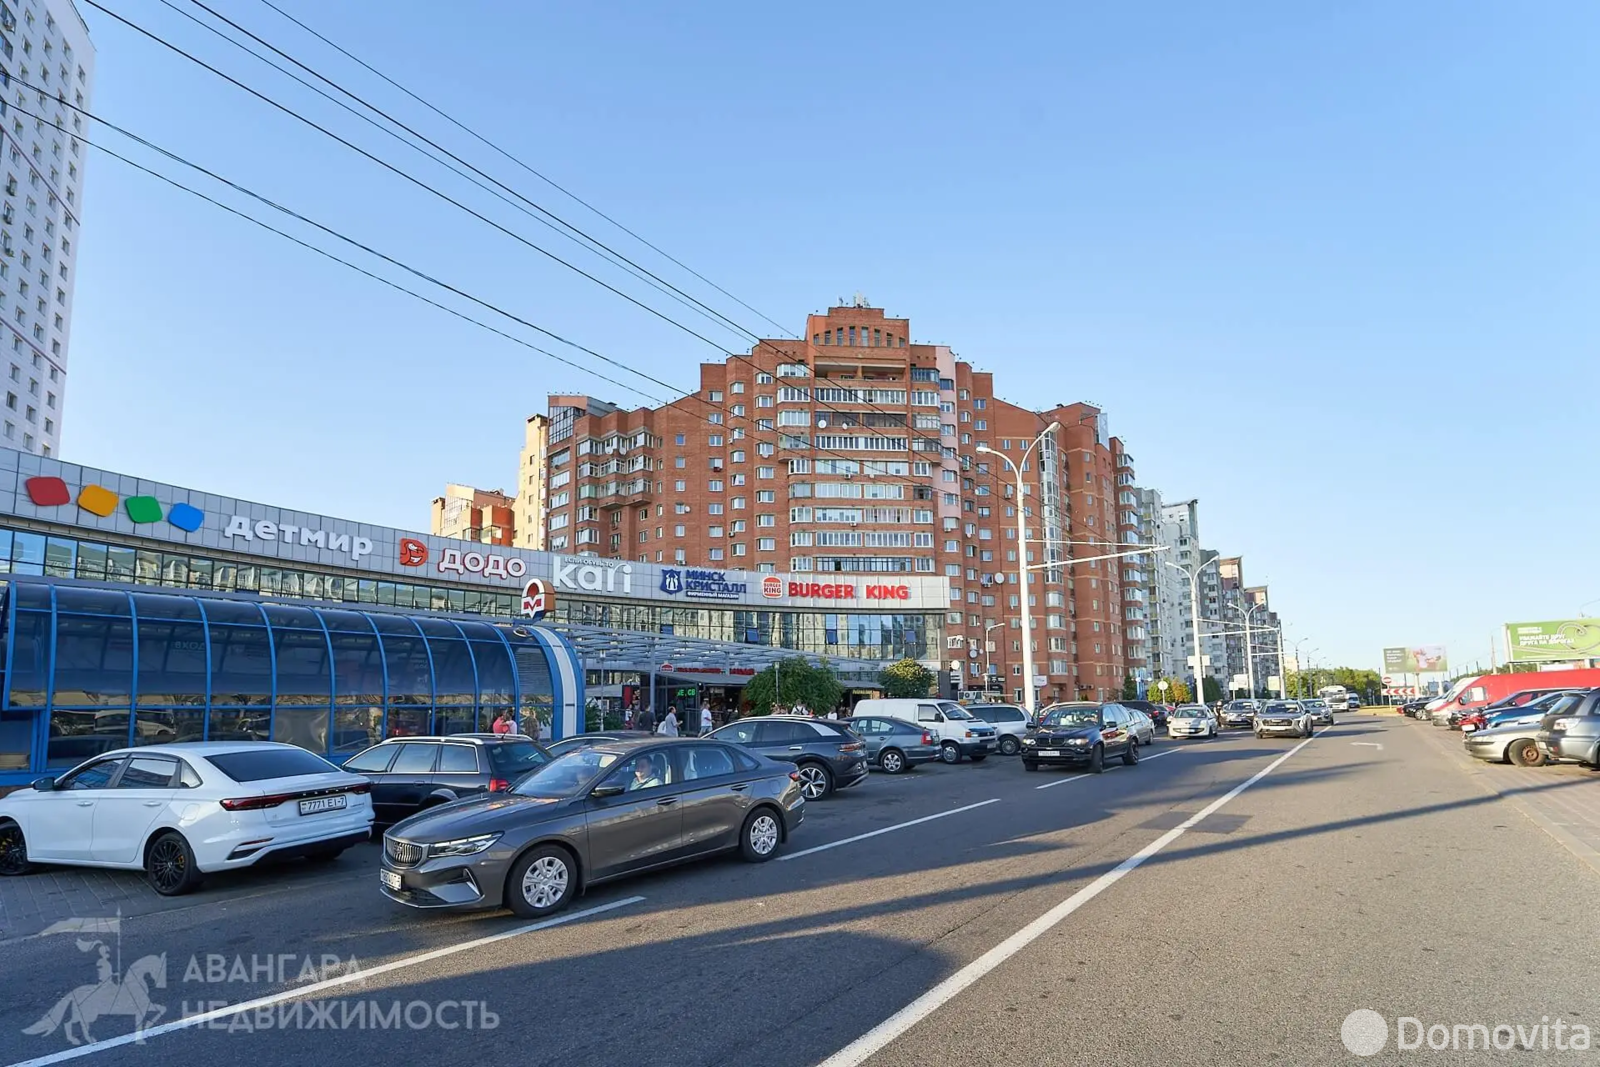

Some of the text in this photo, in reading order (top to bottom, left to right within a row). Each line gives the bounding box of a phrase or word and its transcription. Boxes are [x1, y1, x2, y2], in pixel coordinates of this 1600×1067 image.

[224, 515, 373, 560] детмир
[553, 555, 632, 593] kari
[686, 570, 726, 581] МИНСК
[686, 580, 747, 593] КРИСТАЛЛ
[788, 582, 909, 600] BURGER KING
[307, 801, 325, 811] 7771
